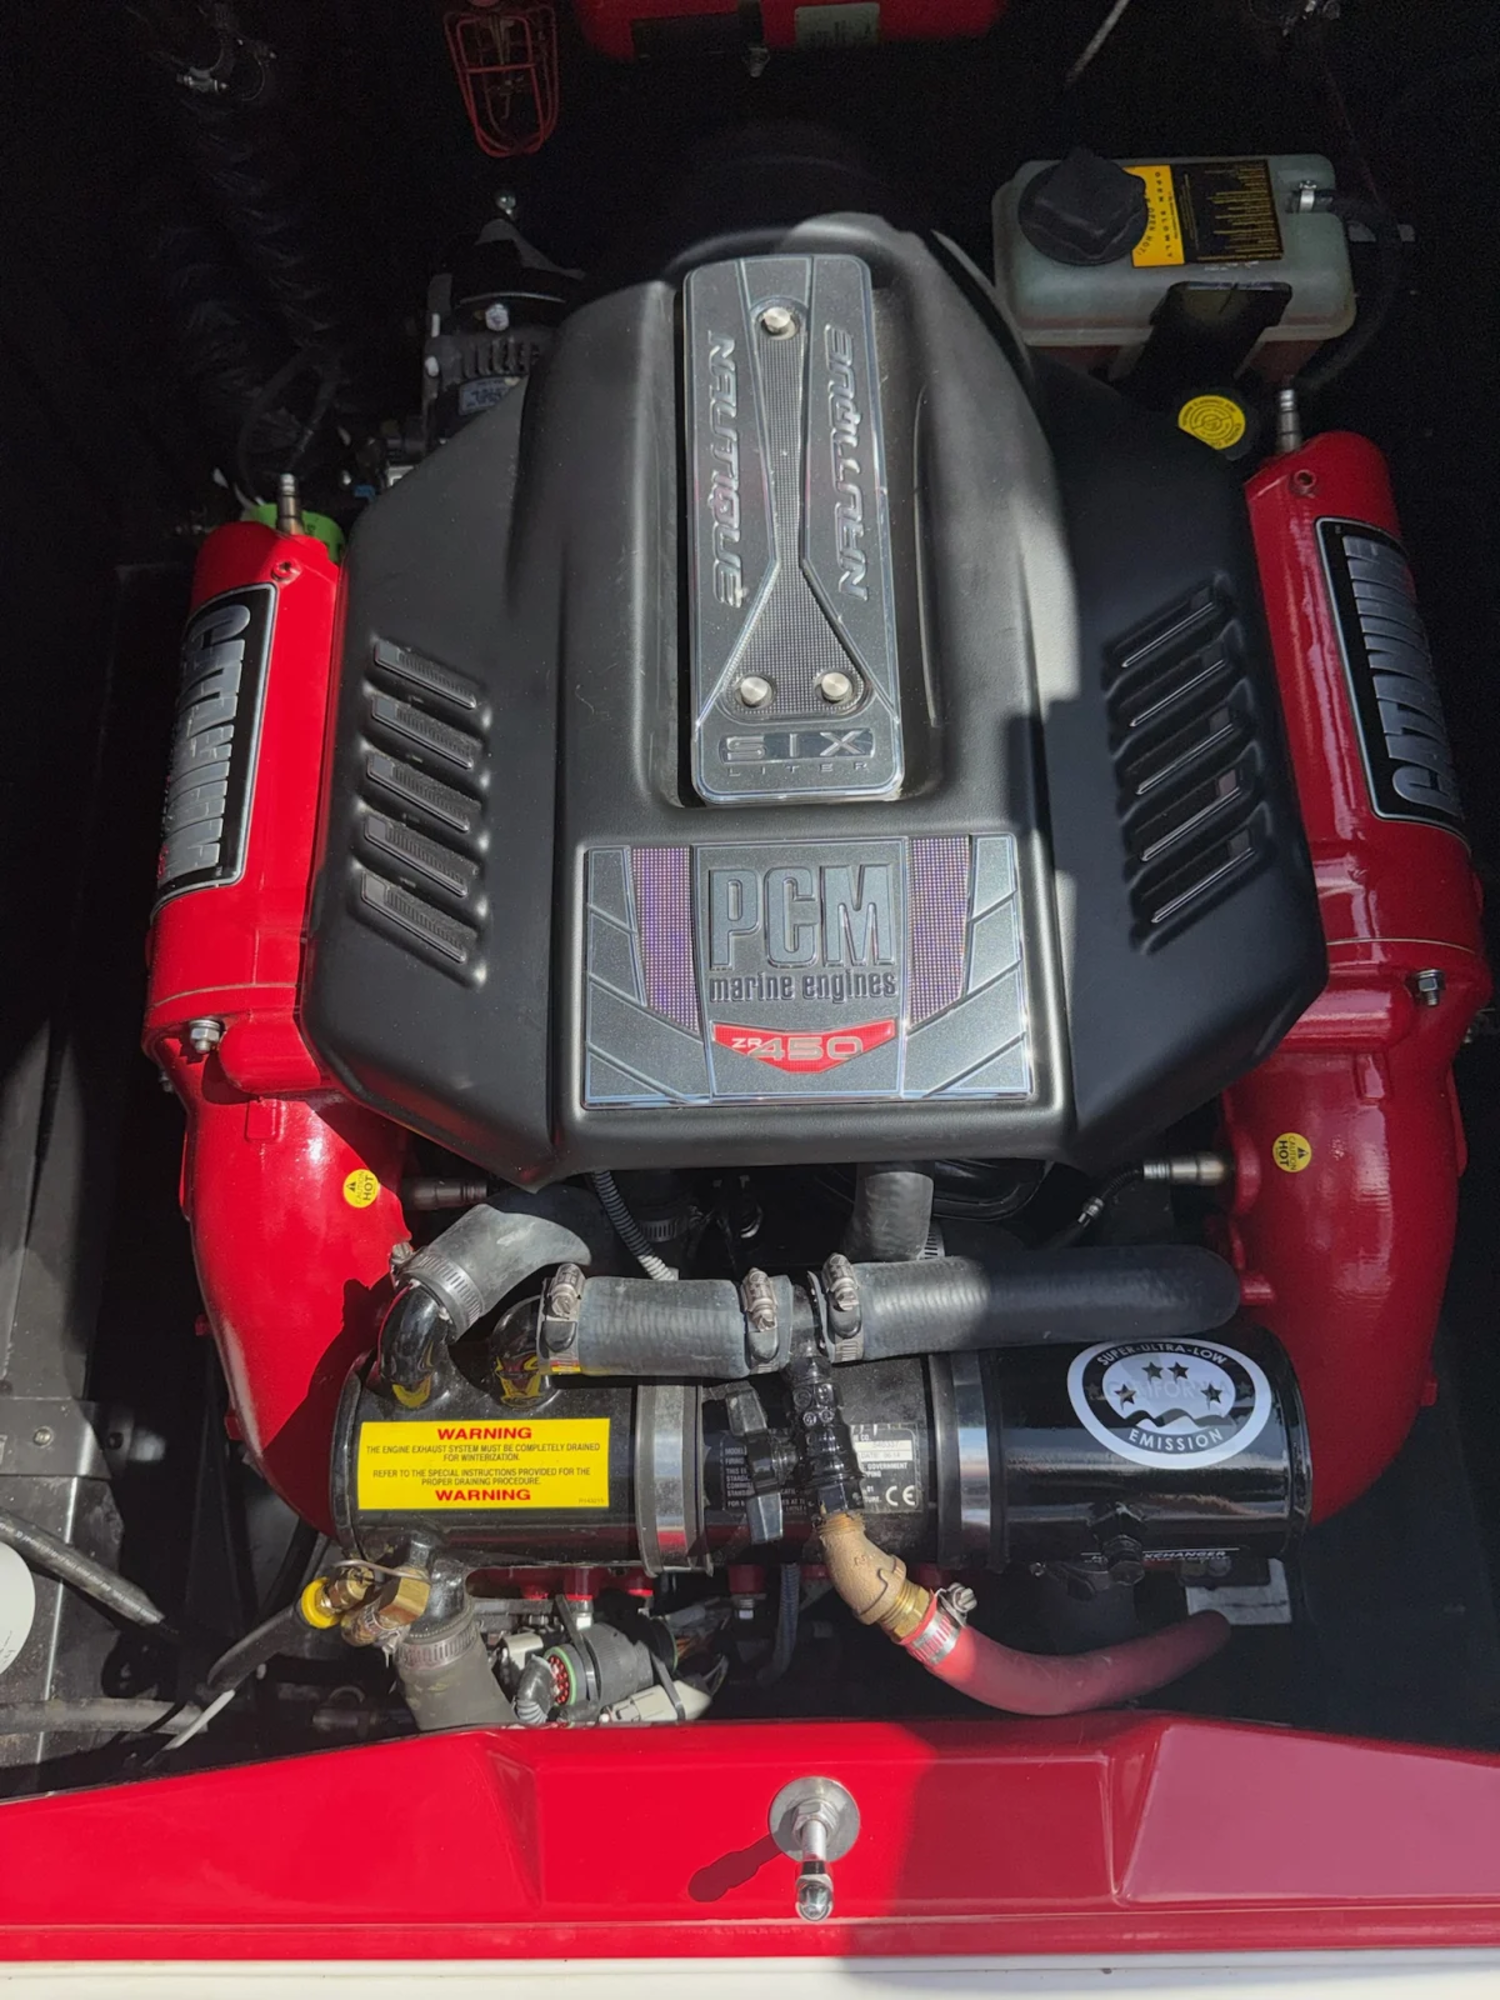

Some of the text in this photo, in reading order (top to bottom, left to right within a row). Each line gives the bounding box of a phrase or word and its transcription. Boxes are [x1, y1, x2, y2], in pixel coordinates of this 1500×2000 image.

[708, 330, 747, 608] NAUTIQUE
[825, 324, 868, 600] NAUTIQUE
[726, 730, 867, 760] SIX
[729, 763, 869, 777] LITER
[709, 864, 895, 970] PCM
[710, 969, 897, 1004] marine engines
[1279, 1140, 1290, 1166] HOT
[363, 1175, 374, 1201] HOT
[437, 1427, 532, 1440] WARNING
[1128, 1428, 1224, 1451] EMISSION
[367, 1443, 600, 1454] THE ENGINE EXHAUST SYSTEM MUST BE COMPLETELY DRAINED
[443, 1453, 521, 1462] FOR WINTERIZATION.
[373, 1466, 590, 1478] REFER TO THE SPECIAL INSTRUCTIONS PROVIDED FOR THE
[867, 1462, 908, 1470] GOVERNMENT
[421, 1476, 541, 1486] PROPER DRAINING PROCEDURE.
[435, 1489, 531, 1501] WARNING
[1143, 1551, 1227, 1560] XCHANGER
